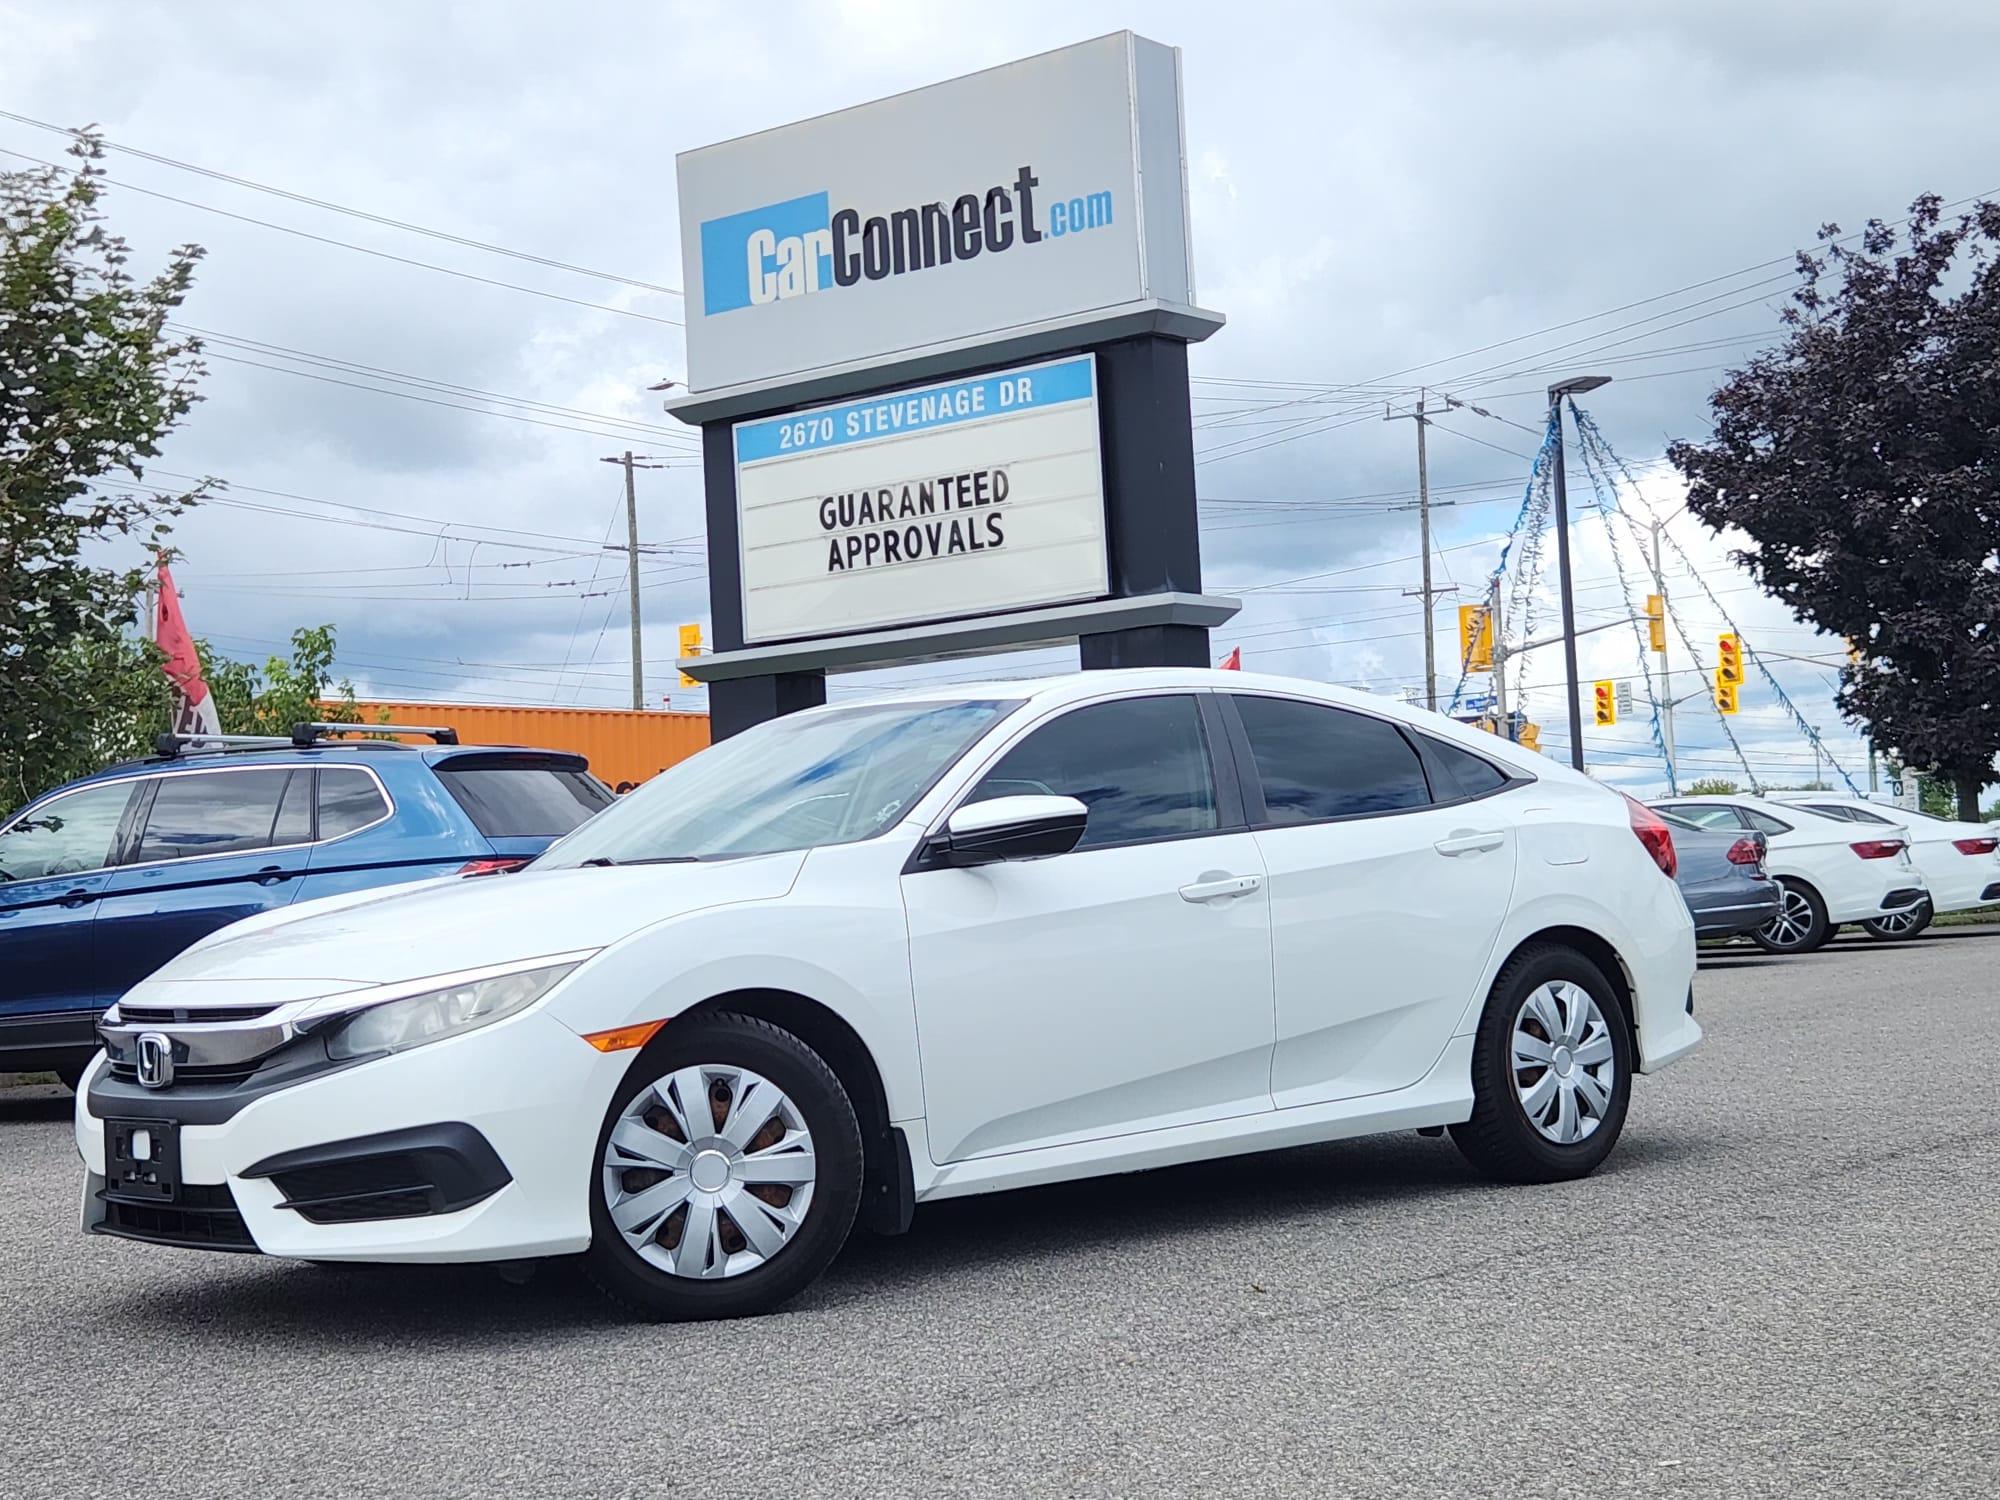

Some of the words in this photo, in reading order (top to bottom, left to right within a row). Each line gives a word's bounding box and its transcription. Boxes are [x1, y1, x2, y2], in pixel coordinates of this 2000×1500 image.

[746, 165, 1113, 305] CarConnect.com
[779, 418, 834, 449] 2670
[846, 386, 986, 437] STEVENAGE
[999, 377, 1033, 407] DR
[819, 469, 1010, 531] GUARANTEED
[828, 512, 1005, 573] APPROVALS
